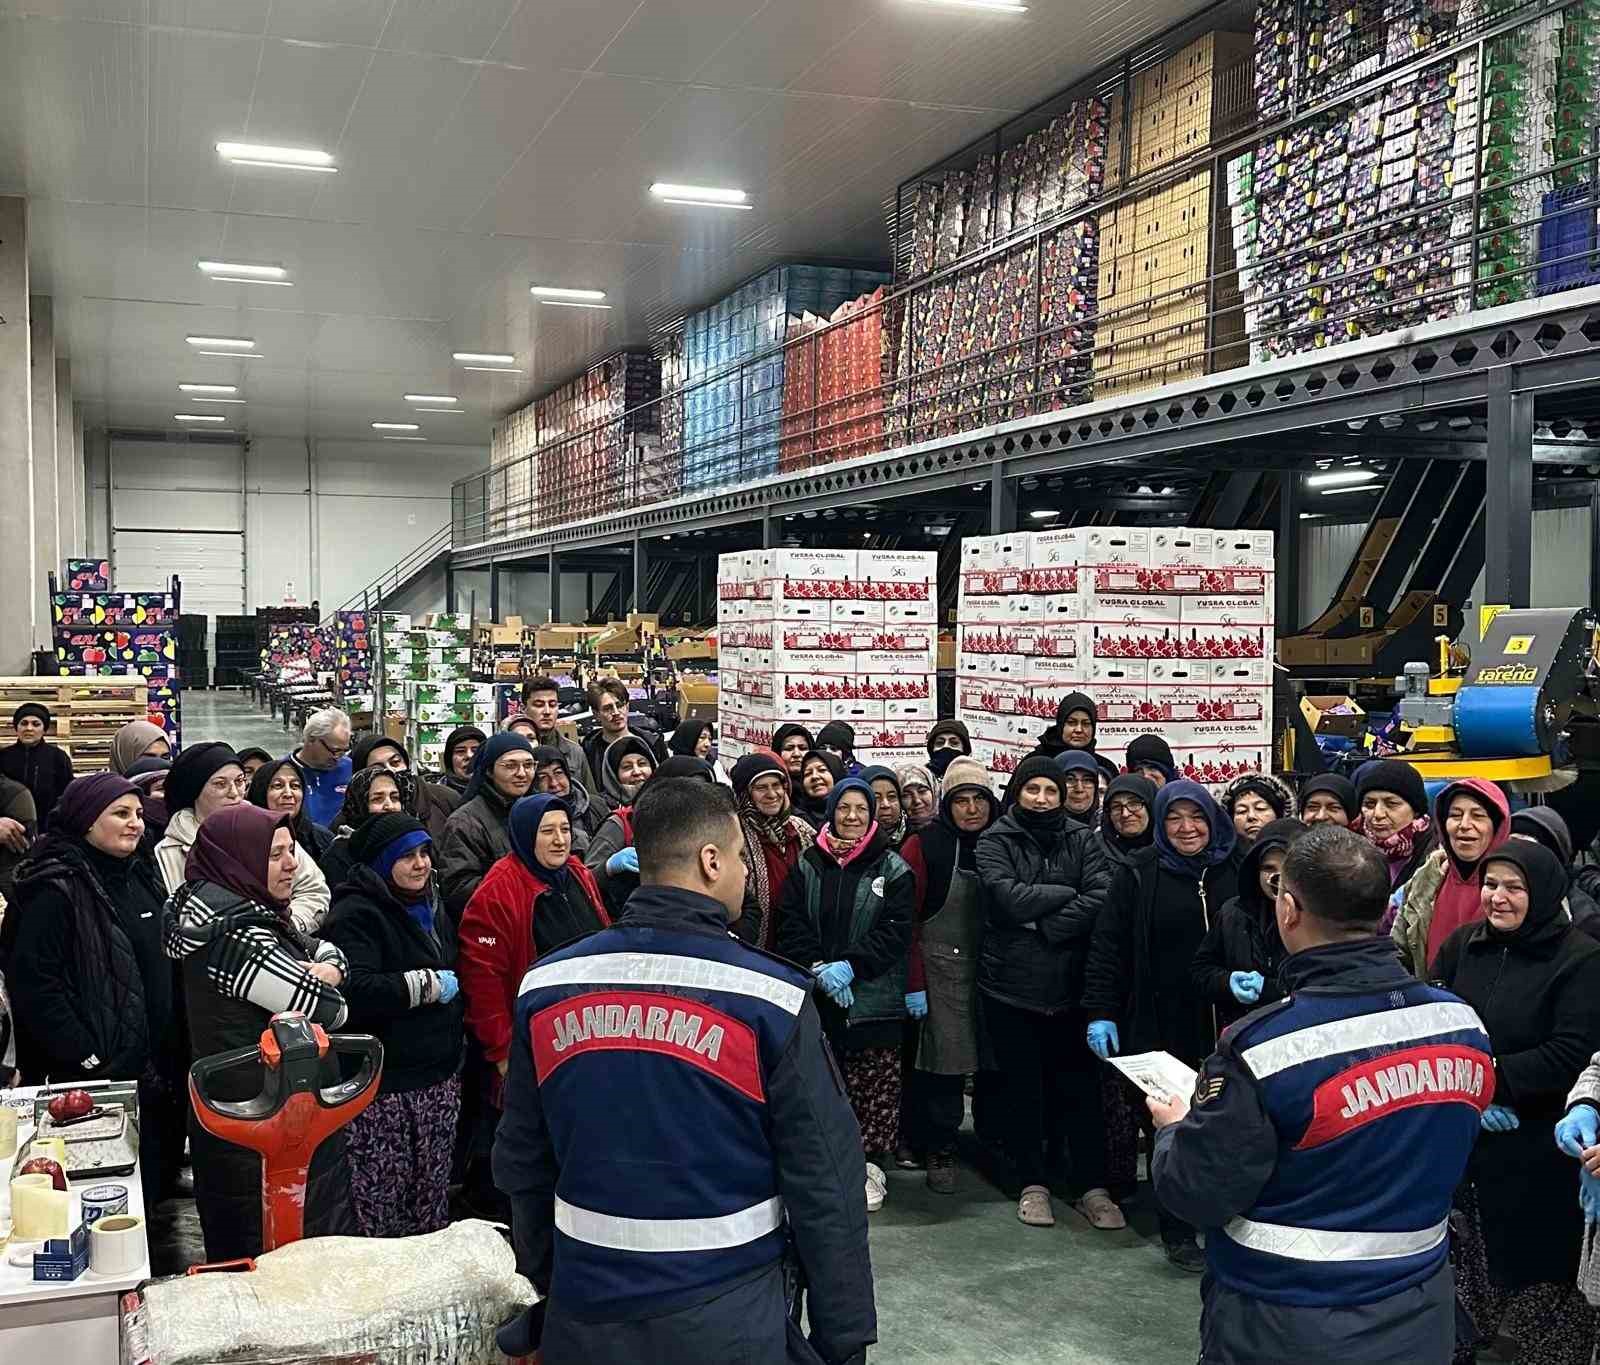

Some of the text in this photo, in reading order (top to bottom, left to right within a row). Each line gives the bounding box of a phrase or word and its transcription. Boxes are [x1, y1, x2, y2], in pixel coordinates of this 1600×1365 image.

[1362, 610, 1371, 624] 6
[1436, 609, 1444, 623] 5
[1512, 640, 1523, 650] 3
[552, 1004, 725, 1061] JANDARMA
[1340, 1058, 1484, 1119] JANDARMA
